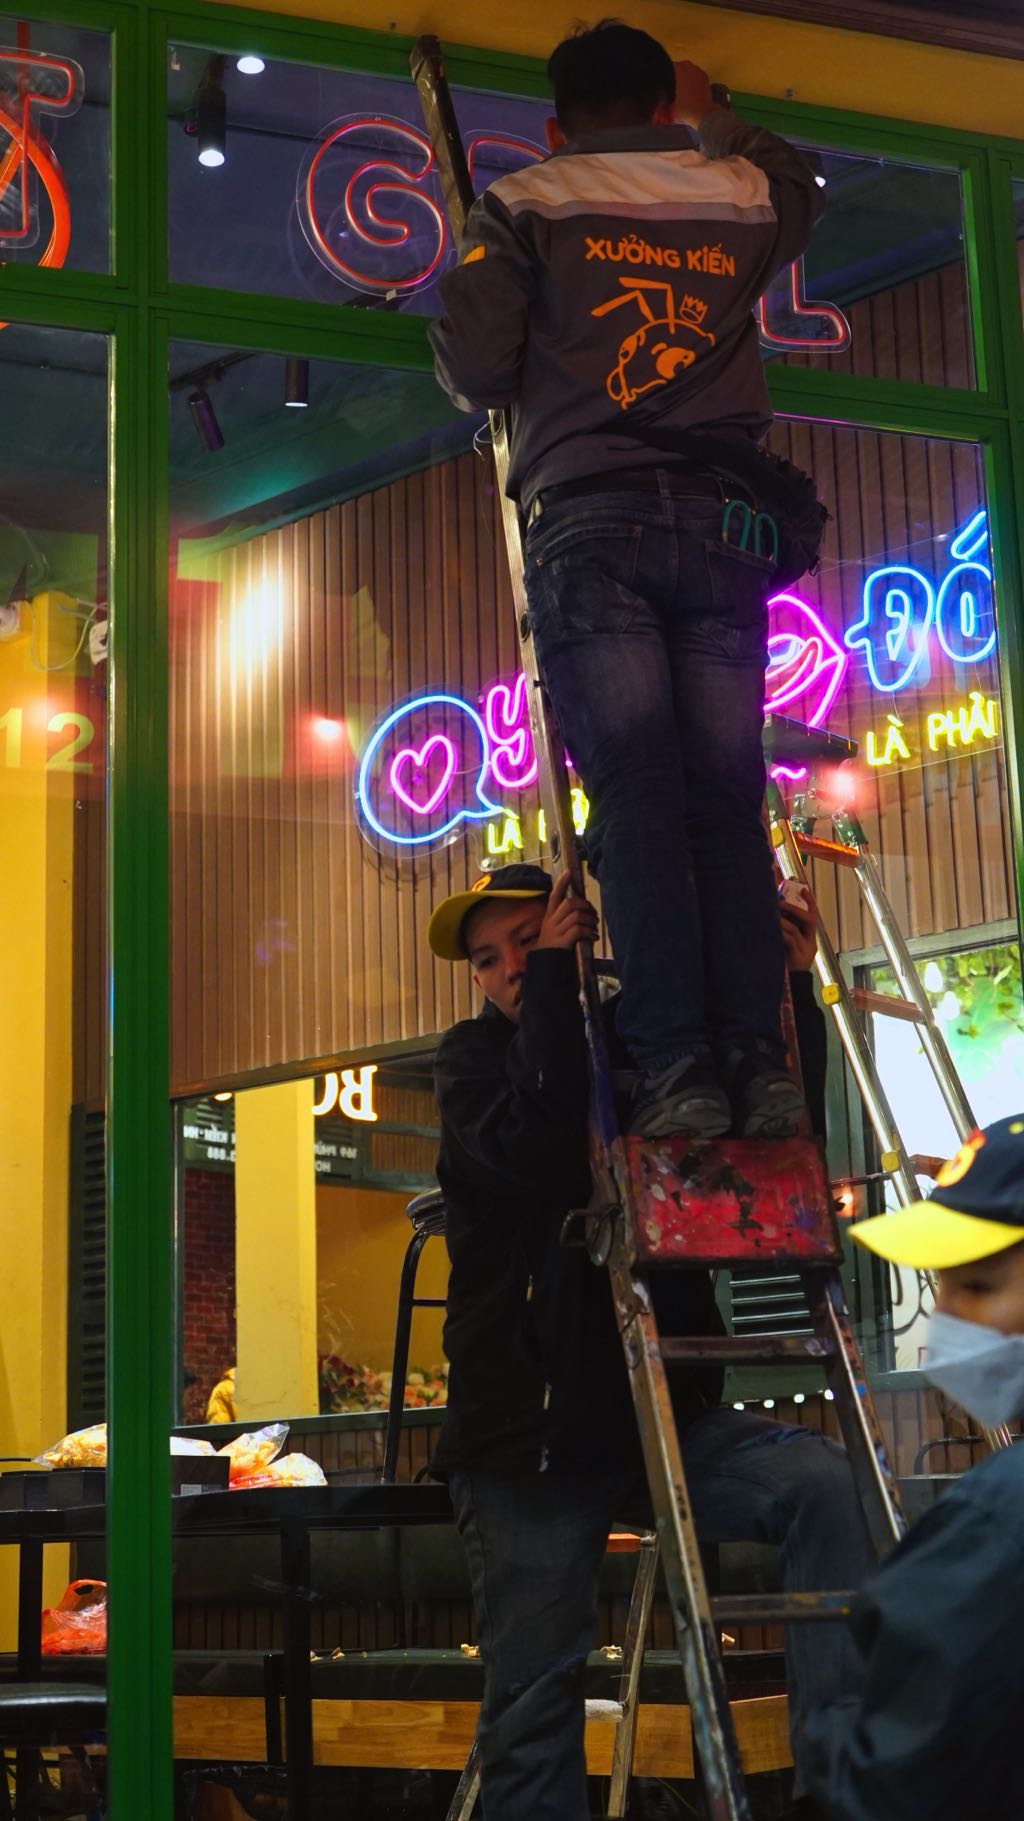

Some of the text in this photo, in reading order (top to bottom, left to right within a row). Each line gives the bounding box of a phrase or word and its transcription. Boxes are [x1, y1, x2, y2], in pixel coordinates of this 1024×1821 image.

[585, 234, 681, 269] XƯỞNG
[866, 691, 999, 767] LÀ PHẢI
[488, 808, 524, 853] LÀ
